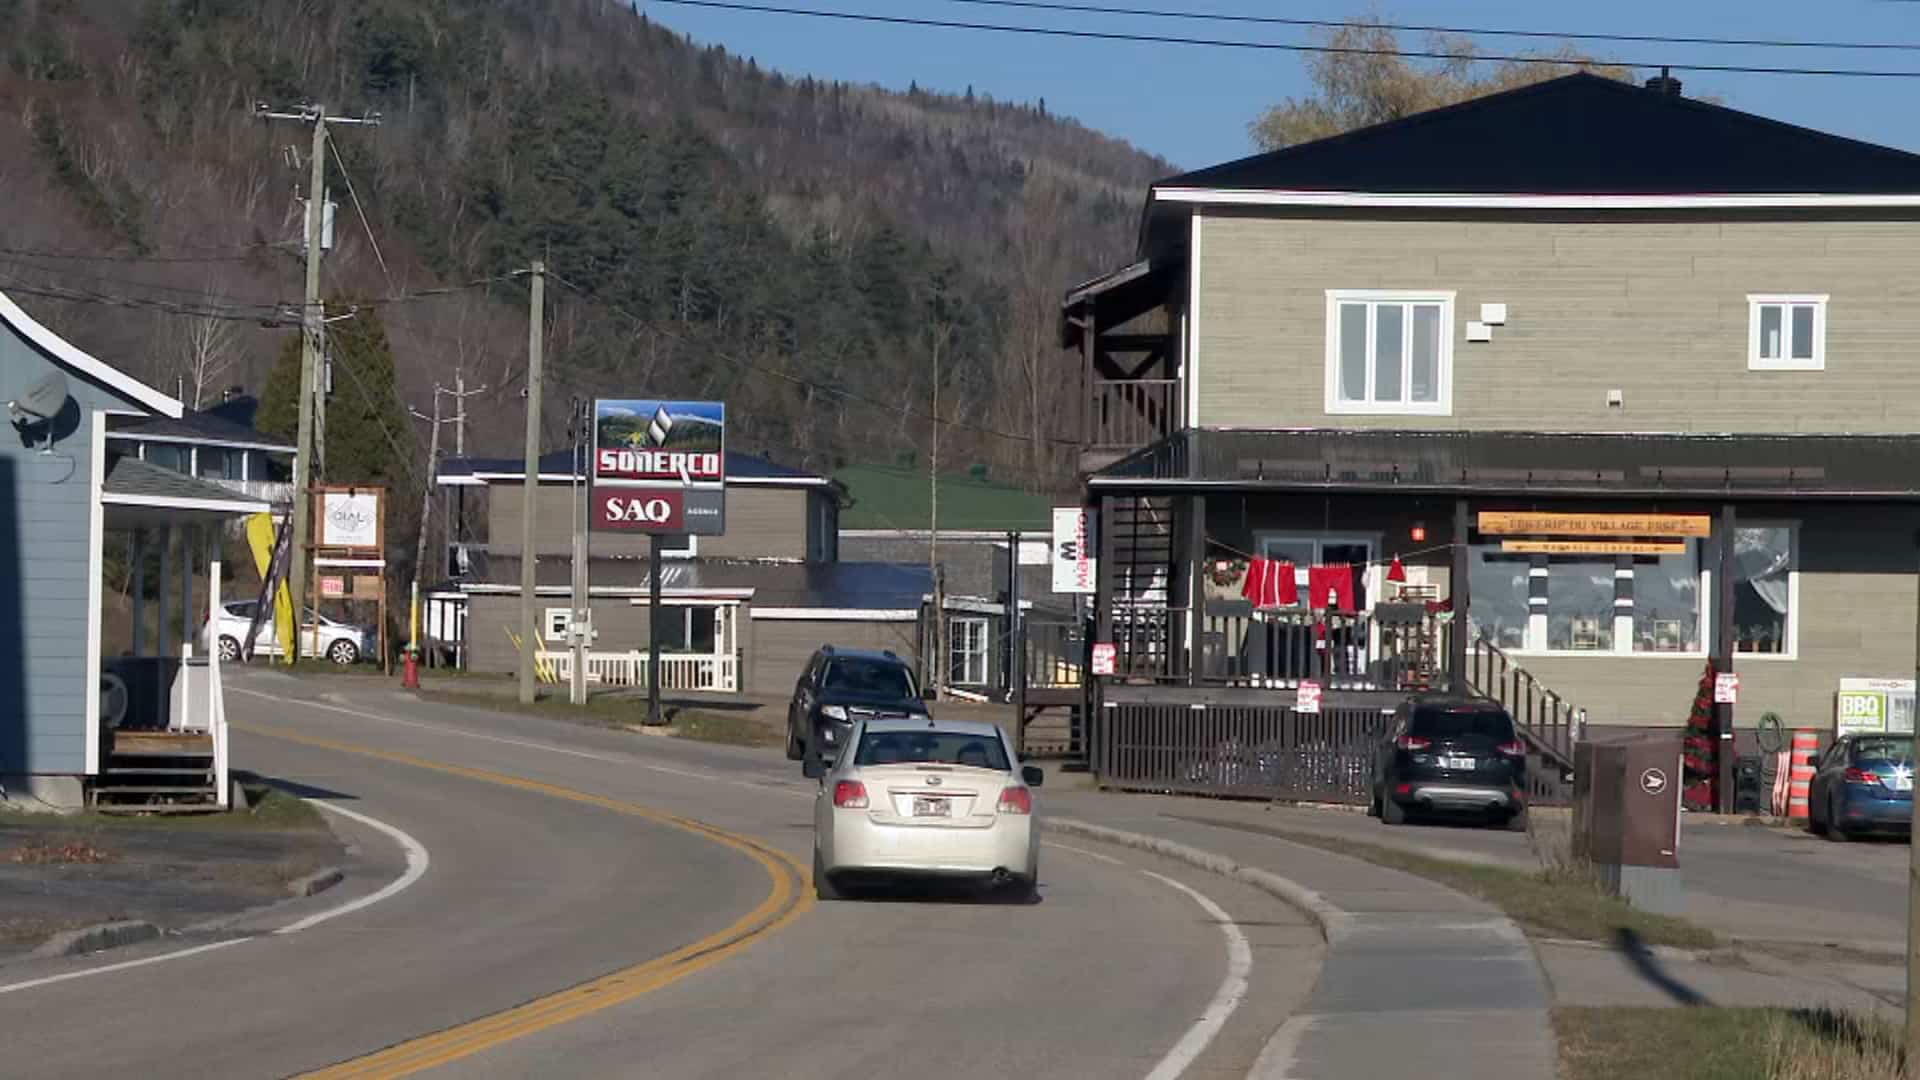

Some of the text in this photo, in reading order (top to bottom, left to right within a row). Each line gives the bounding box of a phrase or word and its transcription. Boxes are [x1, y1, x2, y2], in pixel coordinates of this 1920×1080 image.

[600, 449, 720, 485] SONERCO
[605, 497, 671, 522] SAQ
[1842, 695, 1879, 715] BBQ
